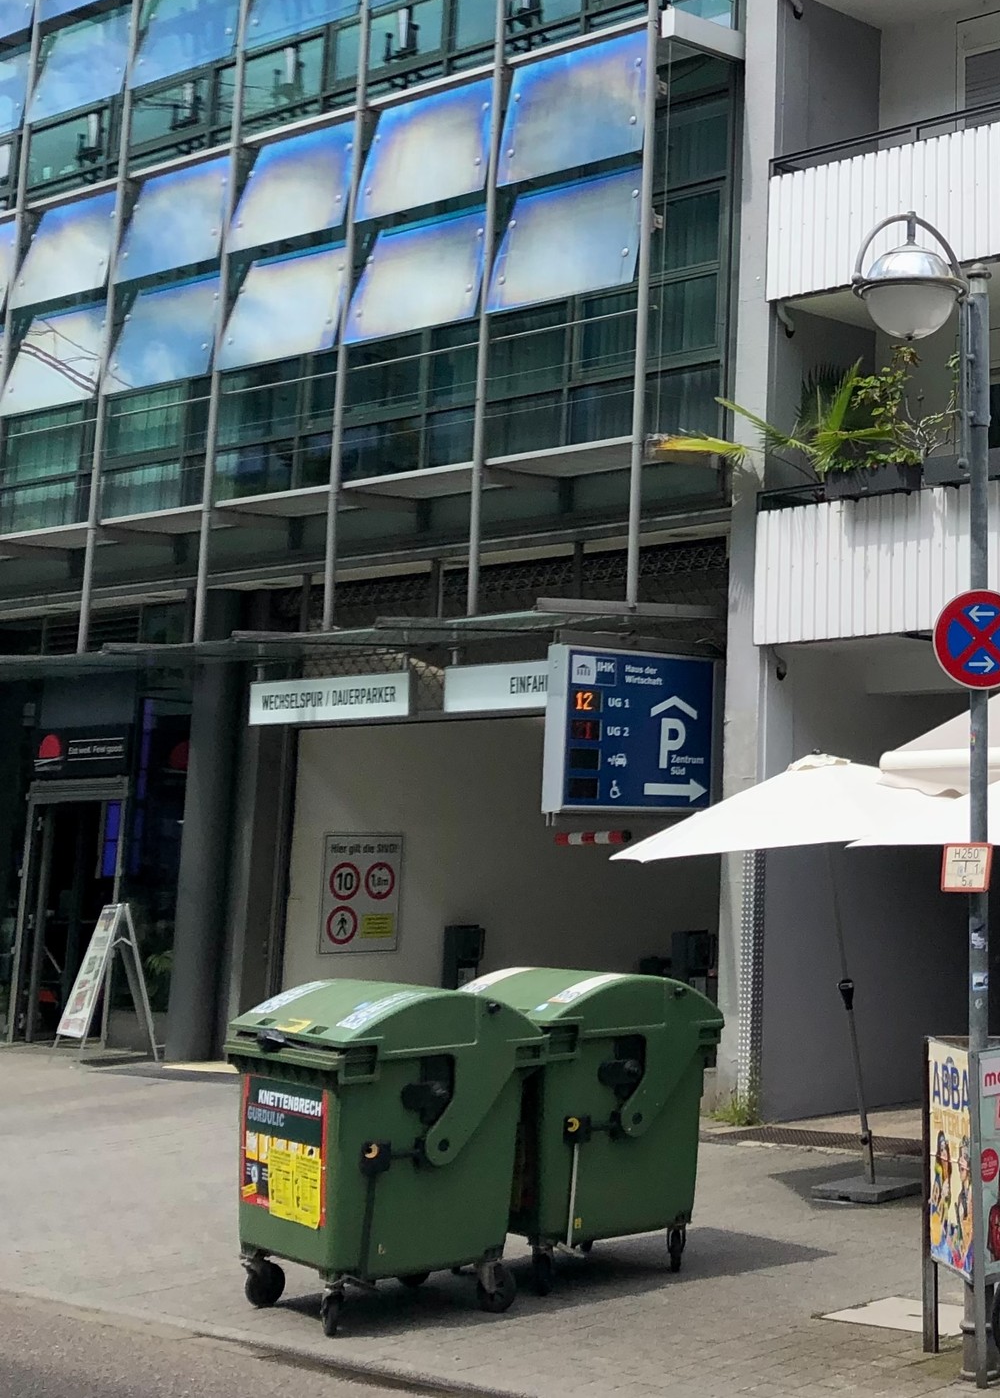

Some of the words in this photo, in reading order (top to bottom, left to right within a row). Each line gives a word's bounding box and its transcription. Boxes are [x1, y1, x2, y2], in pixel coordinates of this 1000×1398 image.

[597, 661, 615, 673] IHK
[625, 664, 643, 674] Haus
[645, 665, 658, 675] der
[510, 674, 549, 694] EINFAH
[625, 675, 663, 686] Wirtschaft
[261, 691, 323, 712] WECHSELSPUR
[332, 685, 396, 707] DAUERPARKER
[575, 691, 594, 710] 12
[607, 697, 622, 708] UG
[607, 726, 621, 737] UG
[622, 727, 630, 737] 2
[670, 754, 704, 765] Zentrum
[670, 766, 686, 776] Süd
[336, 872, 354, 891] 10
[932, 1061, 970, 1112] ABBA
[257, 1088, 323, 1118] KNETTENBRECH
[246, 1104, 286, 1128] GURDULIC
